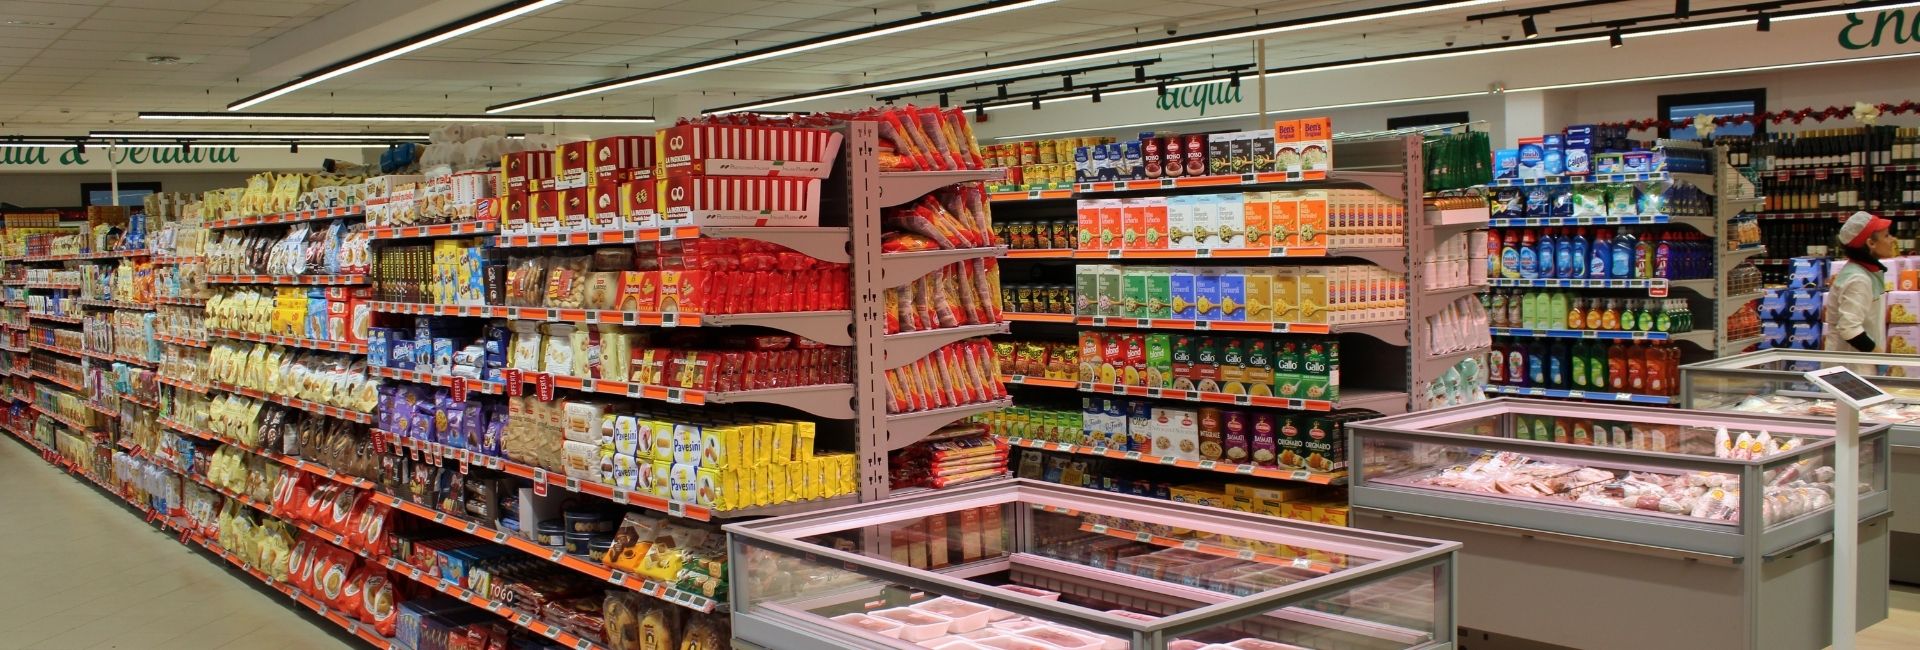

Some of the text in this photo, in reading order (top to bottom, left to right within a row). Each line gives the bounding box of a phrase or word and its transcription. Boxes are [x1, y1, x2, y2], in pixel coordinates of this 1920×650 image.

[1279, 125, 1295, 135] Ben's
[1304, 123, 1322, 132] Ben's
[1567, 154, 1588, 168] Calgon
[1083, 345, 1097, 355] blond
[1105, 346, 1119, 356] blond
[1127, 348, 1142, 358] blond
[1149, 349, 1164, 359] blond
[1173, 353, 1190, 361] Gallo
[1199, 353, 1215, 362] Gallo
[1225, 355, 1242, 363] Gallo
[1250, 356, 1267, 365] Gallo
[1278, 360, 1298, 370] Gallo
[1305, 361, 1325, 372] Gallo
[615, 428, 637, 441] Pavesini
[674, 439, 701, 453] Pavesini
[614, 465, 637, 477] Pavesini
[671, 478, 696, 491] Pavesini
[491, 583, 514, 602] TOGO
